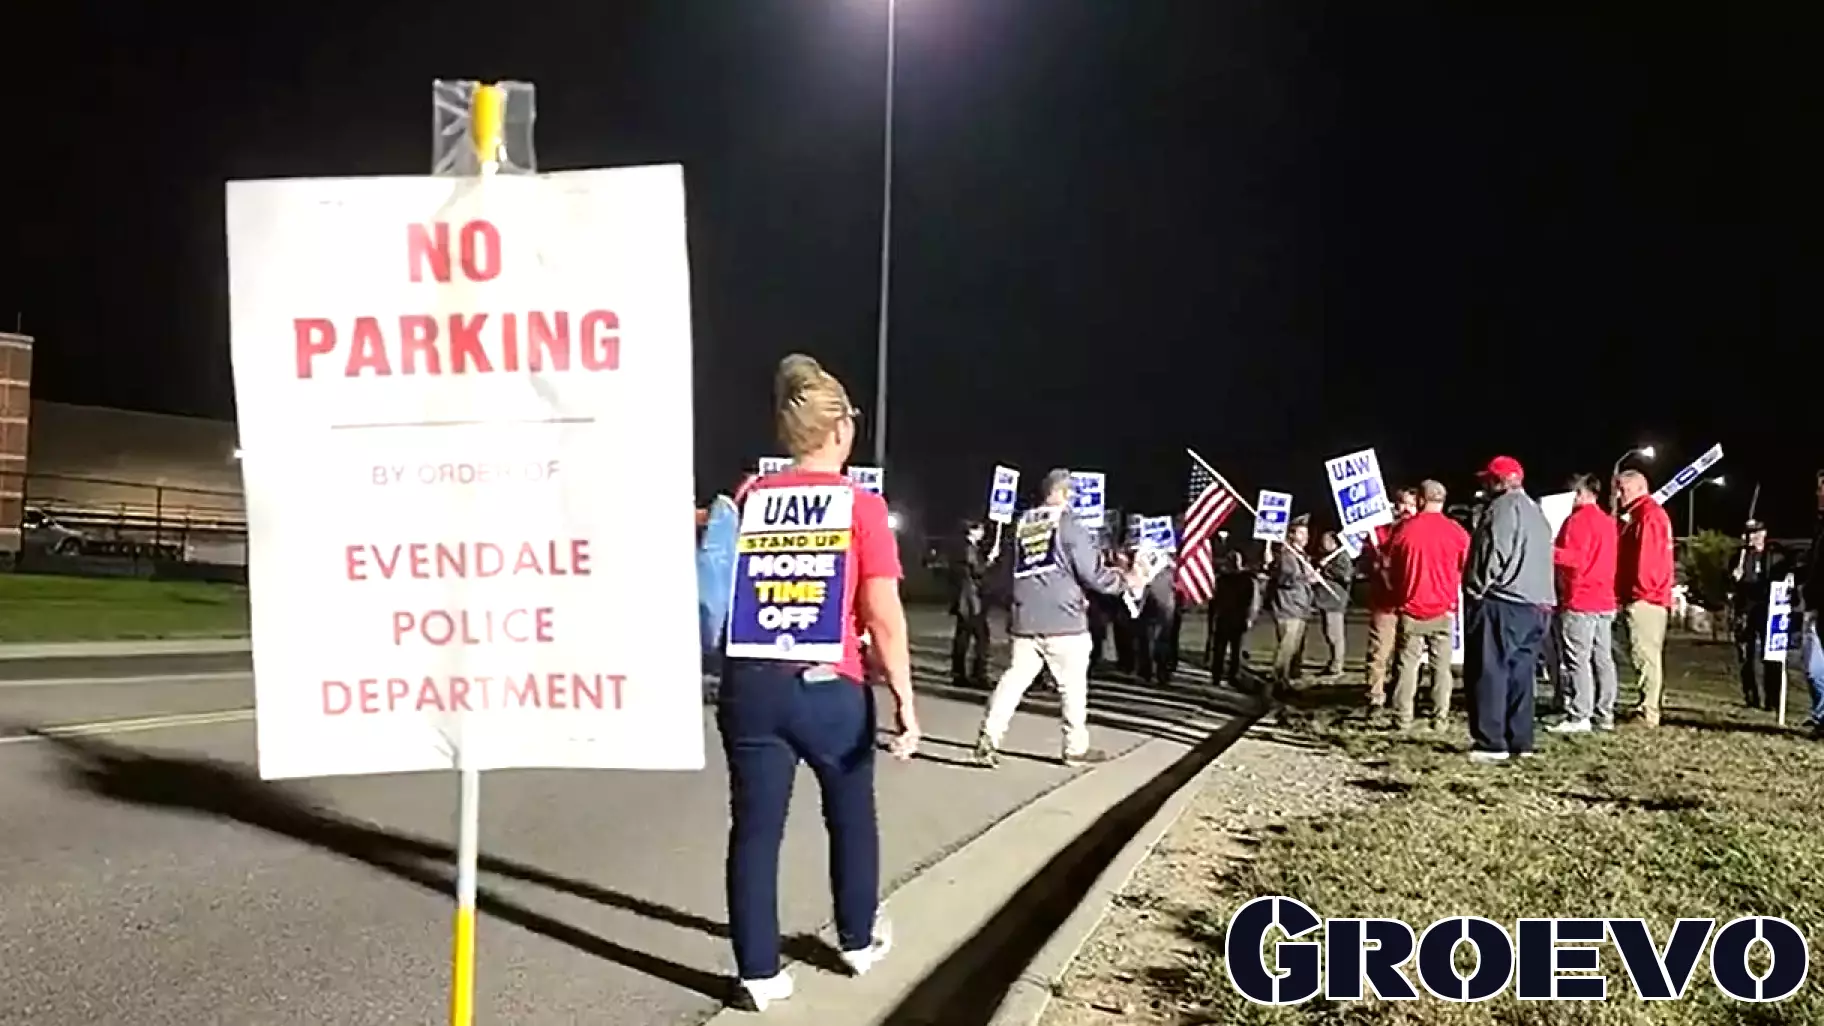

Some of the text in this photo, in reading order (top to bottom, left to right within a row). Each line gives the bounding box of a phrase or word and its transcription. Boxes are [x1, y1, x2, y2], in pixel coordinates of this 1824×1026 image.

[408, 220, 502, 283] NO
[294, 310, 621, 379] PARKING
[372, 464, 405, 485] BY
[1332, 455, 1370, 481] UAW
[764, 494, 832, 525] UAW
[746, 535, 842, 550] STAND UP
[345, 539, 592, 581] EVENDALE
[748, 554, 836, 577] MORE
[755, 580, 827, 604] TIME
[392, 607, 556, 646] POLICE
[758, 606, 820, 630] OFF
[322, 673, 628, 716] DEPARTMENT
